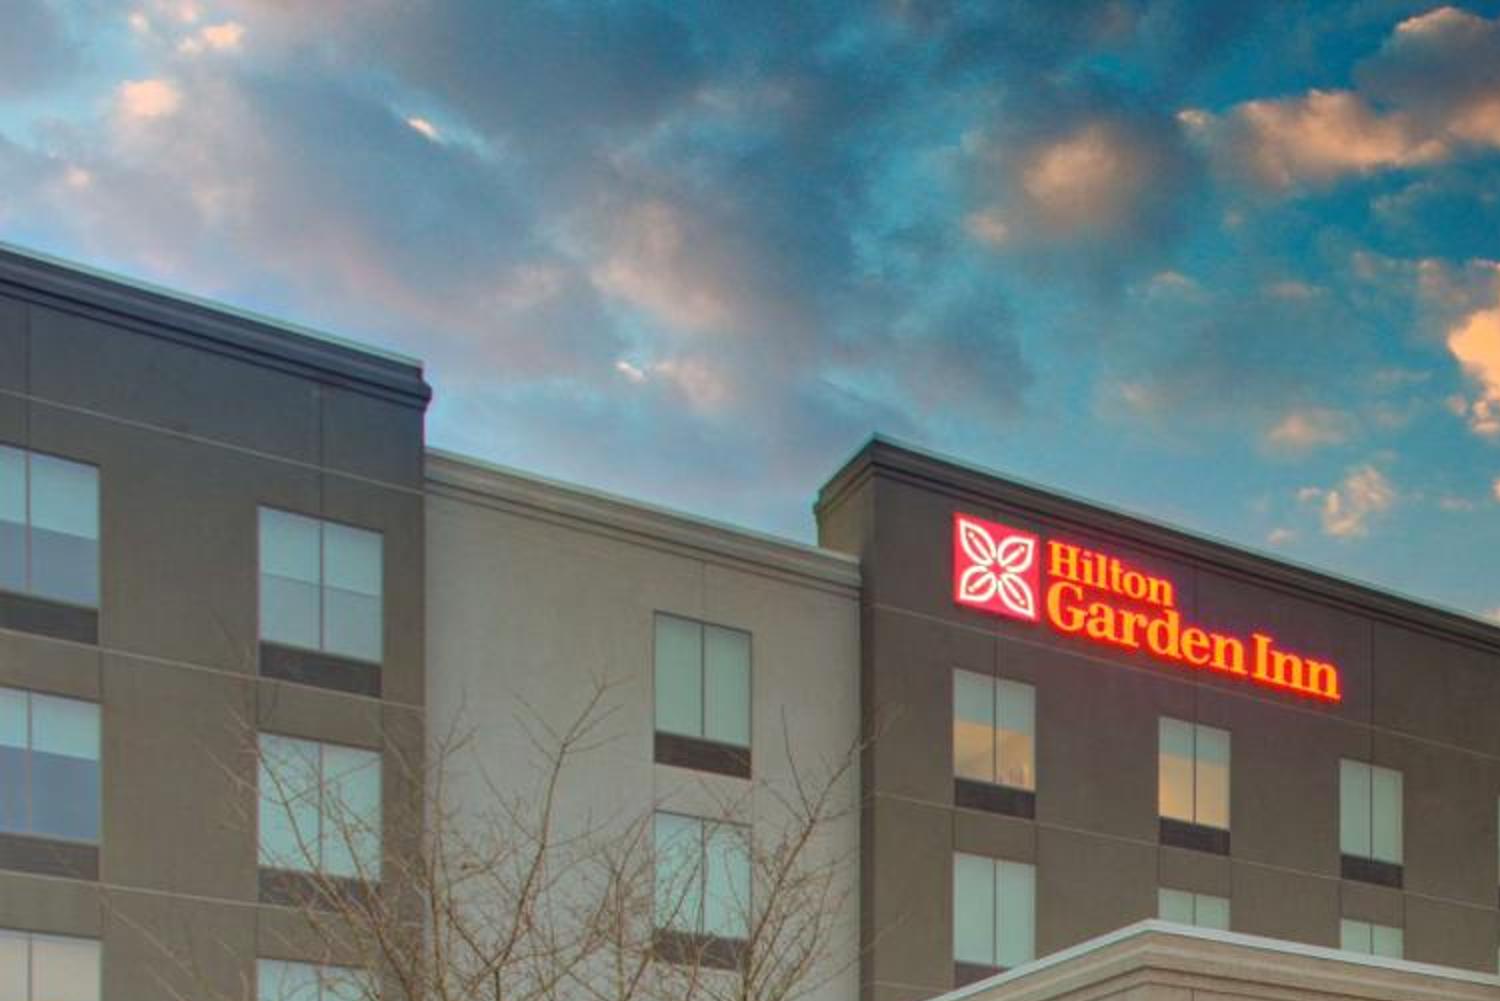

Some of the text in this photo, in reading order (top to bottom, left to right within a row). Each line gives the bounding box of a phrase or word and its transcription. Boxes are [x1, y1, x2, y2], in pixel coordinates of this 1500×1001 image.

[1047, 540, 1173, 606] Hilton
[1046, 581, 1341, 700] Garden Inn
